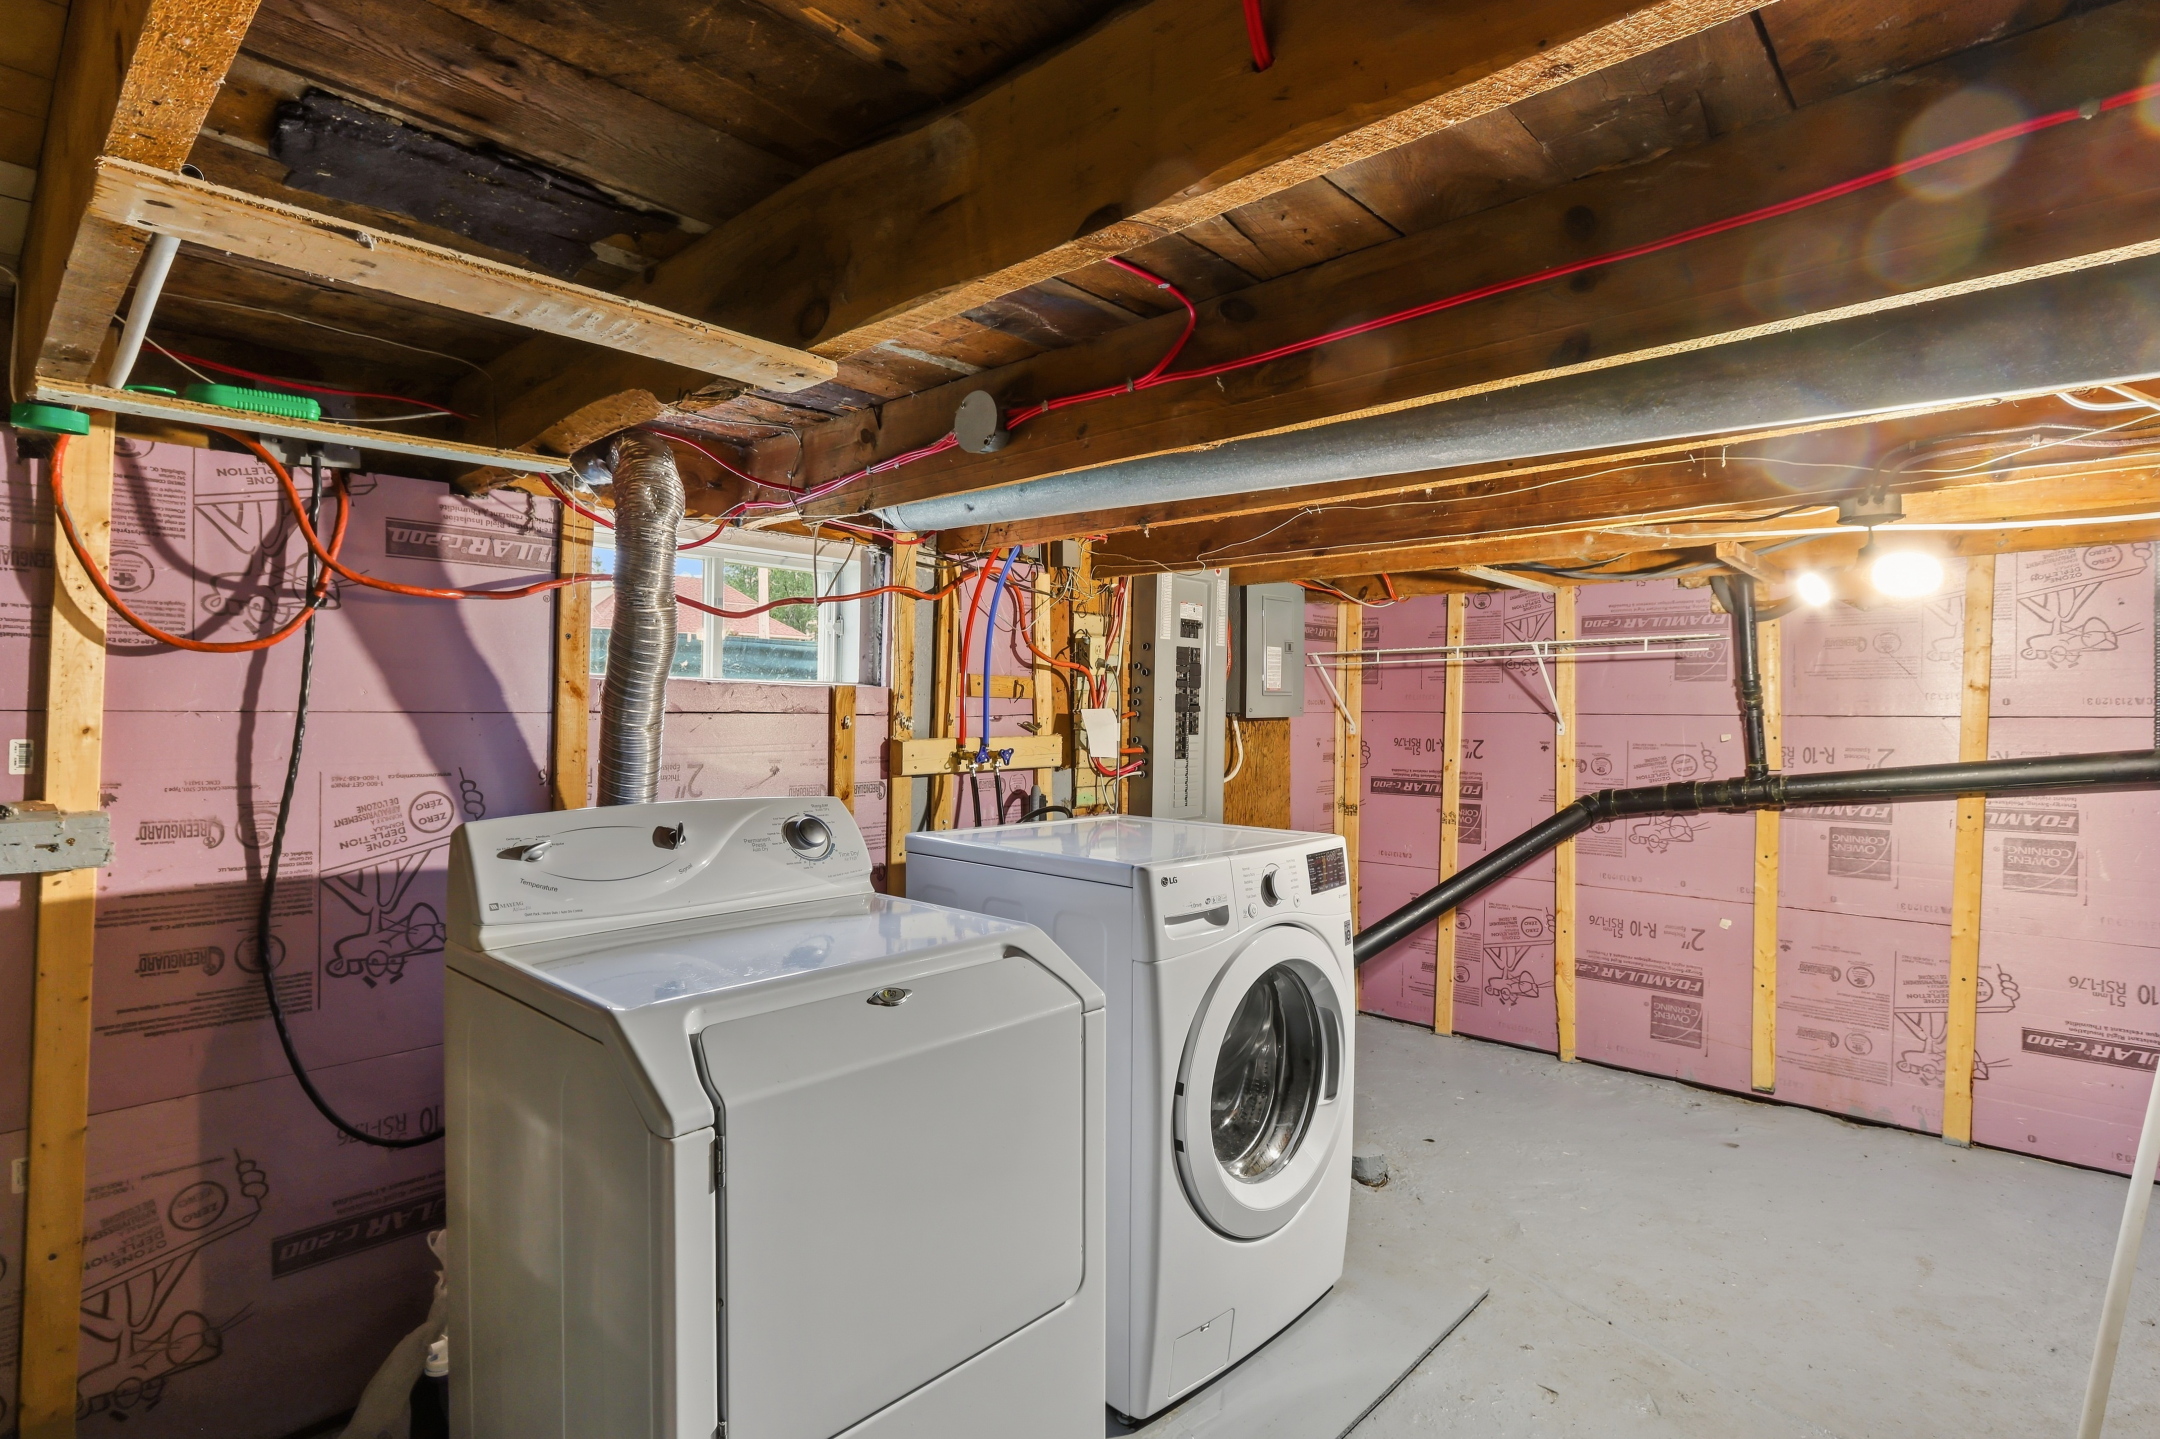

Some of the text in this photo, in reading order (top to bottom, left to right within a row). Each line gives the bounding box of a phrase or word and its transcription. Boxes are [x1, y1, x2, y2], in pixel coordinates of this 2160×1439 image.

[2091, 555, 2118, 567] ZERO
[2029, 566, 2082, 583] DEPLETION
[2047, 572, 2084, 584] OZONE
[1584, 614, 1727, 629] FOAMULAR C-200
[1393, 737, 1422, 747] RSI-1.76
[1412, 747, 1422, 756] 51
[1465, 739, 1485, 760] 2"
[1802, 746, 1836, 765] R-10
[1782, 757, 1795, 769] 51
[1372, 780, 1402, 789] C-200
[356, 797, 399, 814] DE L'OZONE
[415, 798, 443, 811] ZÉRO
[418, 811, 447, 826] ZERO
[373, 820, 405, 832] FORMULA
[338, 826, 406, 850] DEPLETION
[365, 835, 408, 852] OZONE
[743, 836, 772, 845] Permanent
[751, 841, 767, 849] Press
[1832, 833, 1887, 847] CORNING
[762, 846, 770, 854] Dry
[1832, 843, 1877, 855] OWENS
[2007, 844, 2073, 859] CORNING
[678, 862, 693, 875] Signal
[2006, 855, 2062, 869] OWENS
[519, 877, 559, 894] Temperature
[499, 900, 524, 910] MAYTAG
[1588, 915, 1624, 928] RSI-1.76
[1612, 928, 1624, 939] 51
[1629, 920, 1657, 939] R-10
[1680, 927, 1706, 952] 2"
[1601, 967, 1702, 993] FOAMULAR
[2068, 975, 2128, 995] RSI-1.76
[2092, 991, 2128, 1008] 51 mm
[1653, 1002, 1699, 1017] CORNING
[1652, 1010, 1691, 1024] OWENS
[2068, 1027, 2105, 1038] Insulation
[2106, 1032, 2126, 1042] Rigid
[2026, 1033, 2088, 1052] C-200
[181, 1202, 217, 1223] ZERO
